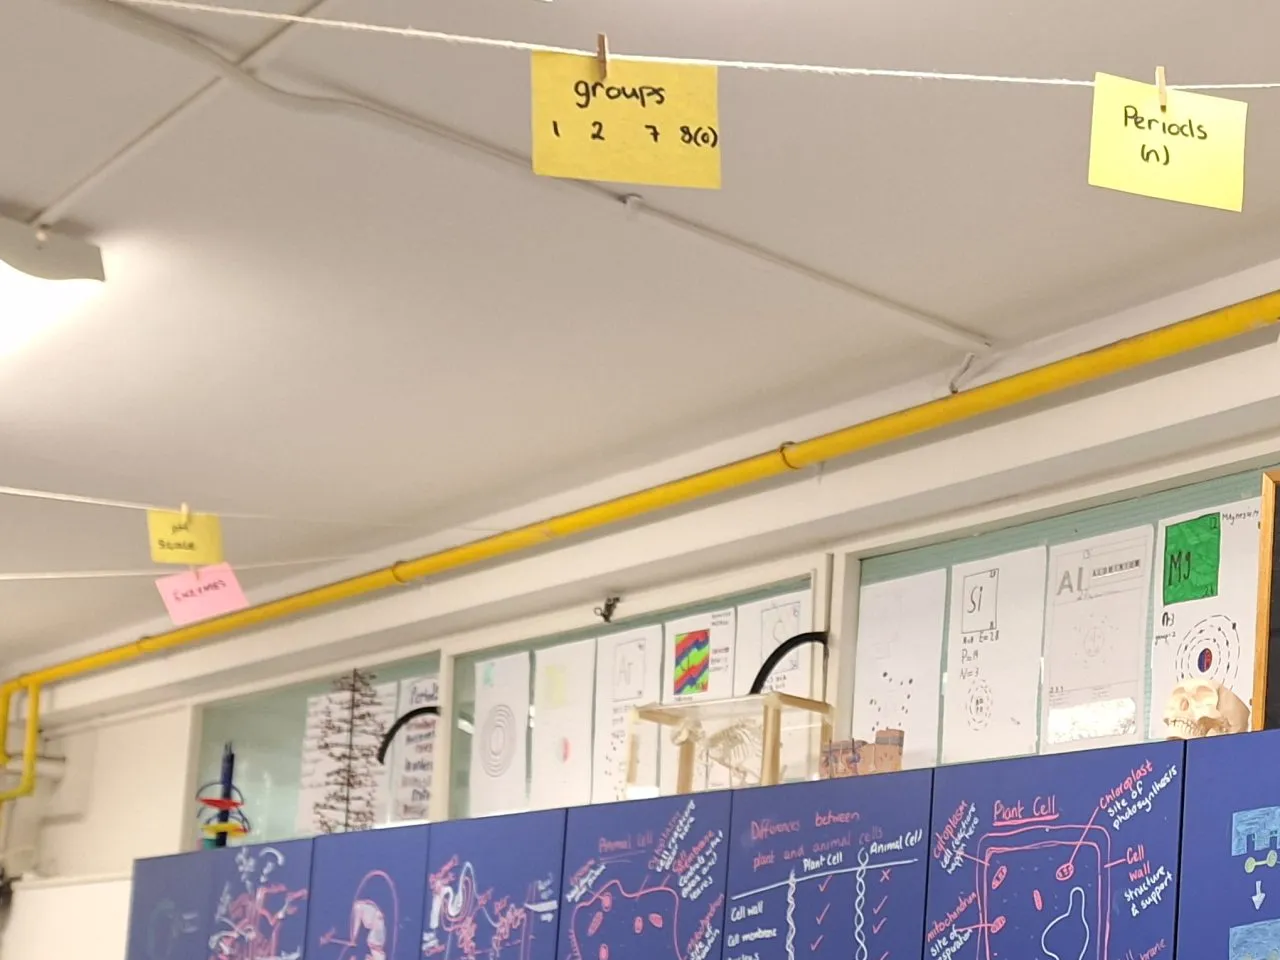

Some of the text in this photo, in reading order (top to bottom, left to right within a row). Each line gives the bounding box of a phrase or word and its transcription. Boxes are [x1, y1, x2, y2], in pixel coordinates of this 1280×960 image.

[574, 80, 665, 108] groups
[552, 121, 560, 137] 1
[591, 121, 605, 140] 2
[645, 125, 660, 142] 7
[1123, 105, 1208, 140] Periods
[1140, 144, 1170, 165] (n)
[1168, 551, 1192, 587] Mg
[1131, 780, 1143, 800] of
[815, 810, 860, 827] between
[993, 795, 1056, 821] Plant Cell
[870, 836, 902, 855] Animal
[1126, 844, 1145, 865] Cell
[1141, 871, 1173, 909] support
